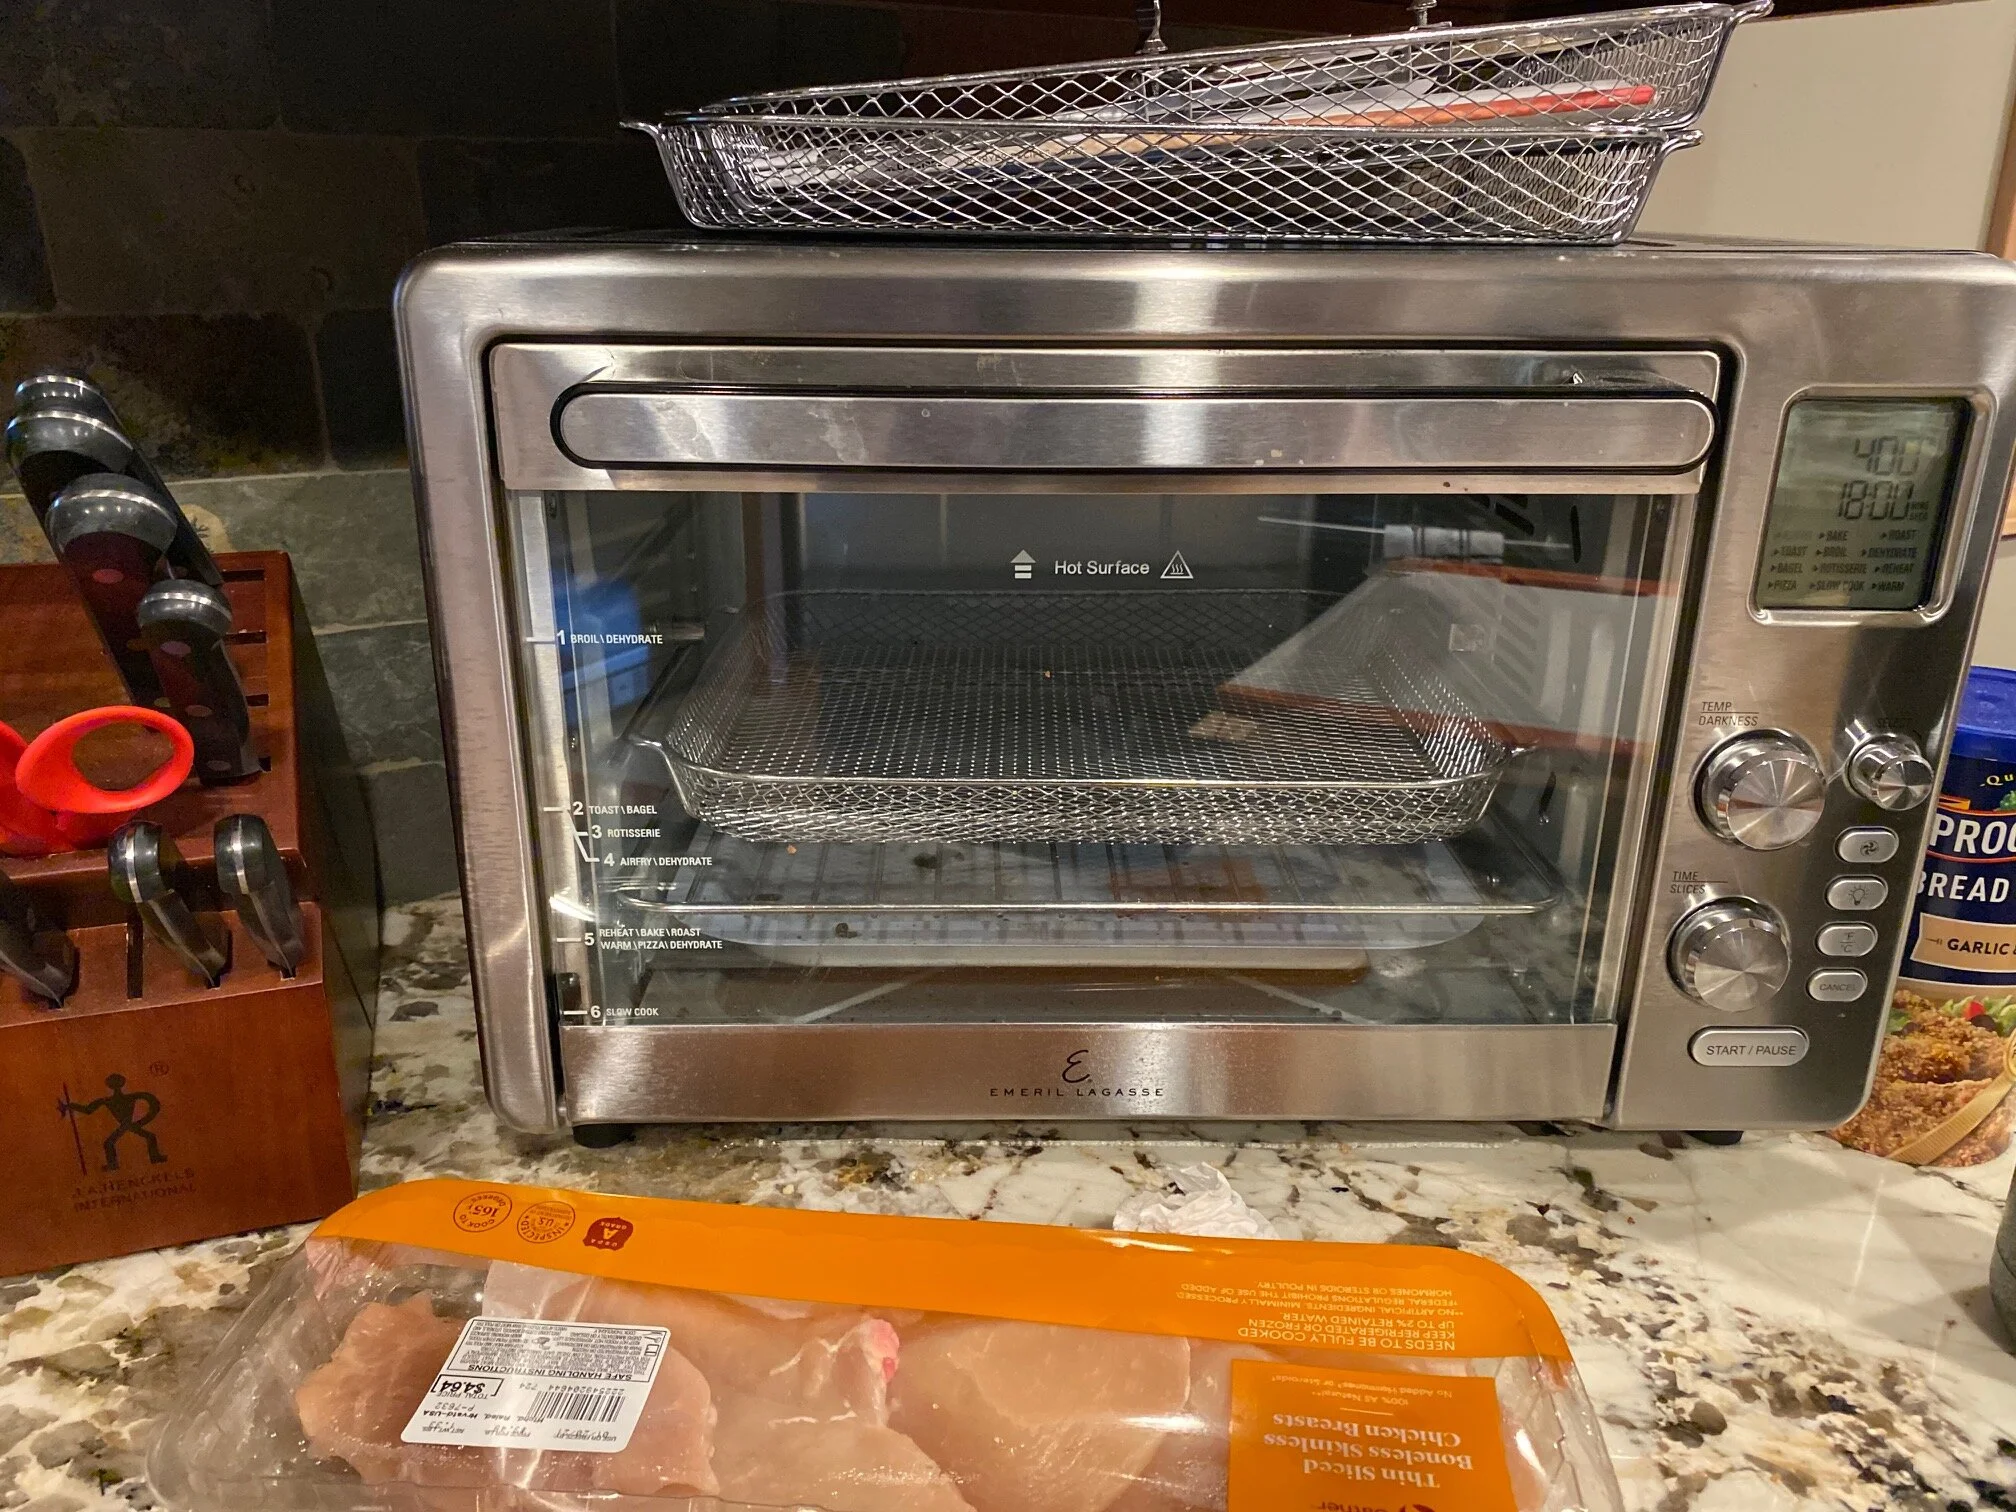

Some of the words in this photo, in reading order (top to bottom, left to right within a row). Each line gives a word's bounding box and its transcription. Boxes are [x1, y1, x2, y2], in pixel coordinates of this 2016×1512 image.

[1854, 435, 1919, 476] 400
[1054, 560, 1082, 575] Hot
[1086, 559, 1150, 575] Surface
[556, 629, 566, 645] 1
[1702, 701, 1732, 712] TEMP
[1699, 715, 1758, 727] DARKNESS
[572, 802, 584, 816] 2
[591, 825, 602, 839] 3
[607, 828, 661, 838] ROTISSERIE
[603, 853, 615, 867] 4
[1673, 871, 1699, 881] TIME
[1670, 884, 1706, 894] SLICES
[584, 932, 595, 946] 5
[1947, 938, 2010, 956] GARLIC
[590, 1005, 601, 1019] 6
[606, 1008, 632, 1017] SLOW
[634, 1008, 659, 1017] COOK
[1706, 1045, 1746, 1056] START
[1755, 1046, 1797, 1056] PAUSE
[990, 1088, 1064, 1097] EMERIL
[1076, 1088, 1164, 1097] LAGASSE
[521, 1220, 565, 1241] INSPECTED
[602, 1228, 619, 1240] A
[1181, 1283, 1217, 1294] ADDED
[1220, 1287, 1235, 1295] OF
[1238, 1288, 1257, 1297] USE
[1307, 1284, 1317, 1292] IN
[1319, 1284, 1370, 1295] STEROIDS
[1372, 1287, 1388, 1295] OR
[1391, 1288, 1452, 1297] HORMONES
[1260, 1290, 1279, 1299] THE
[1282, 1291, 1328, 1301] PROHIBIT
[1332, 1294, 1404, 1306] REGULATIONS
[1240, 1298, 1301, 1309] MINIMALLY
[1379, 1306, 1435, 1316] ARTIFICIAL
[1248, 1319, 1300, 1331] FROZEN
[1330, 1315, 1393, 1328] RETAINED
[1396, 1318, 1414, 1328] 2%
[1417, 1319, 1434, 1329] TO
[1438, 1320, 1455, 1329] UP
[1304, 1323, 1323, 1333] OR
[1323, 1323, 1420, 1339] REFRIGERATED
[1237, 1327, 1306, 1342] COOKED
[1309, 1332, 1354, 1346] FULLY
[1423, 1330, 1455, 1340] KEEP
[1358, 1336, 1376, 1347] BE
[1380, 1338, 1401, 1349] TO
[1405, 1339, 1455, 1351] NEEDS
[468, 1364, 545, 1375] INSTRUCTIONS
[547, 1369, 602, 1379] HANDLING
[604, 1373, 633, 1381] SAFE
[439, 1380, 486, 1394] $4.64
[465, 1392, 488, 1400] TOTAL
[1436, 1389, 1453, 1398] No
[1272, 1413, 1359, 1438] Breasts
[1365, 1424, 1461, 1448] Chicken
[1263, 1433, 1364, 1458] Skinless
[1368, 1446, 1473, 1471] Boneless
[1303, 1459, 1376, 1482] Sliced
[1381, 1468, 1440, 1488] Thin
